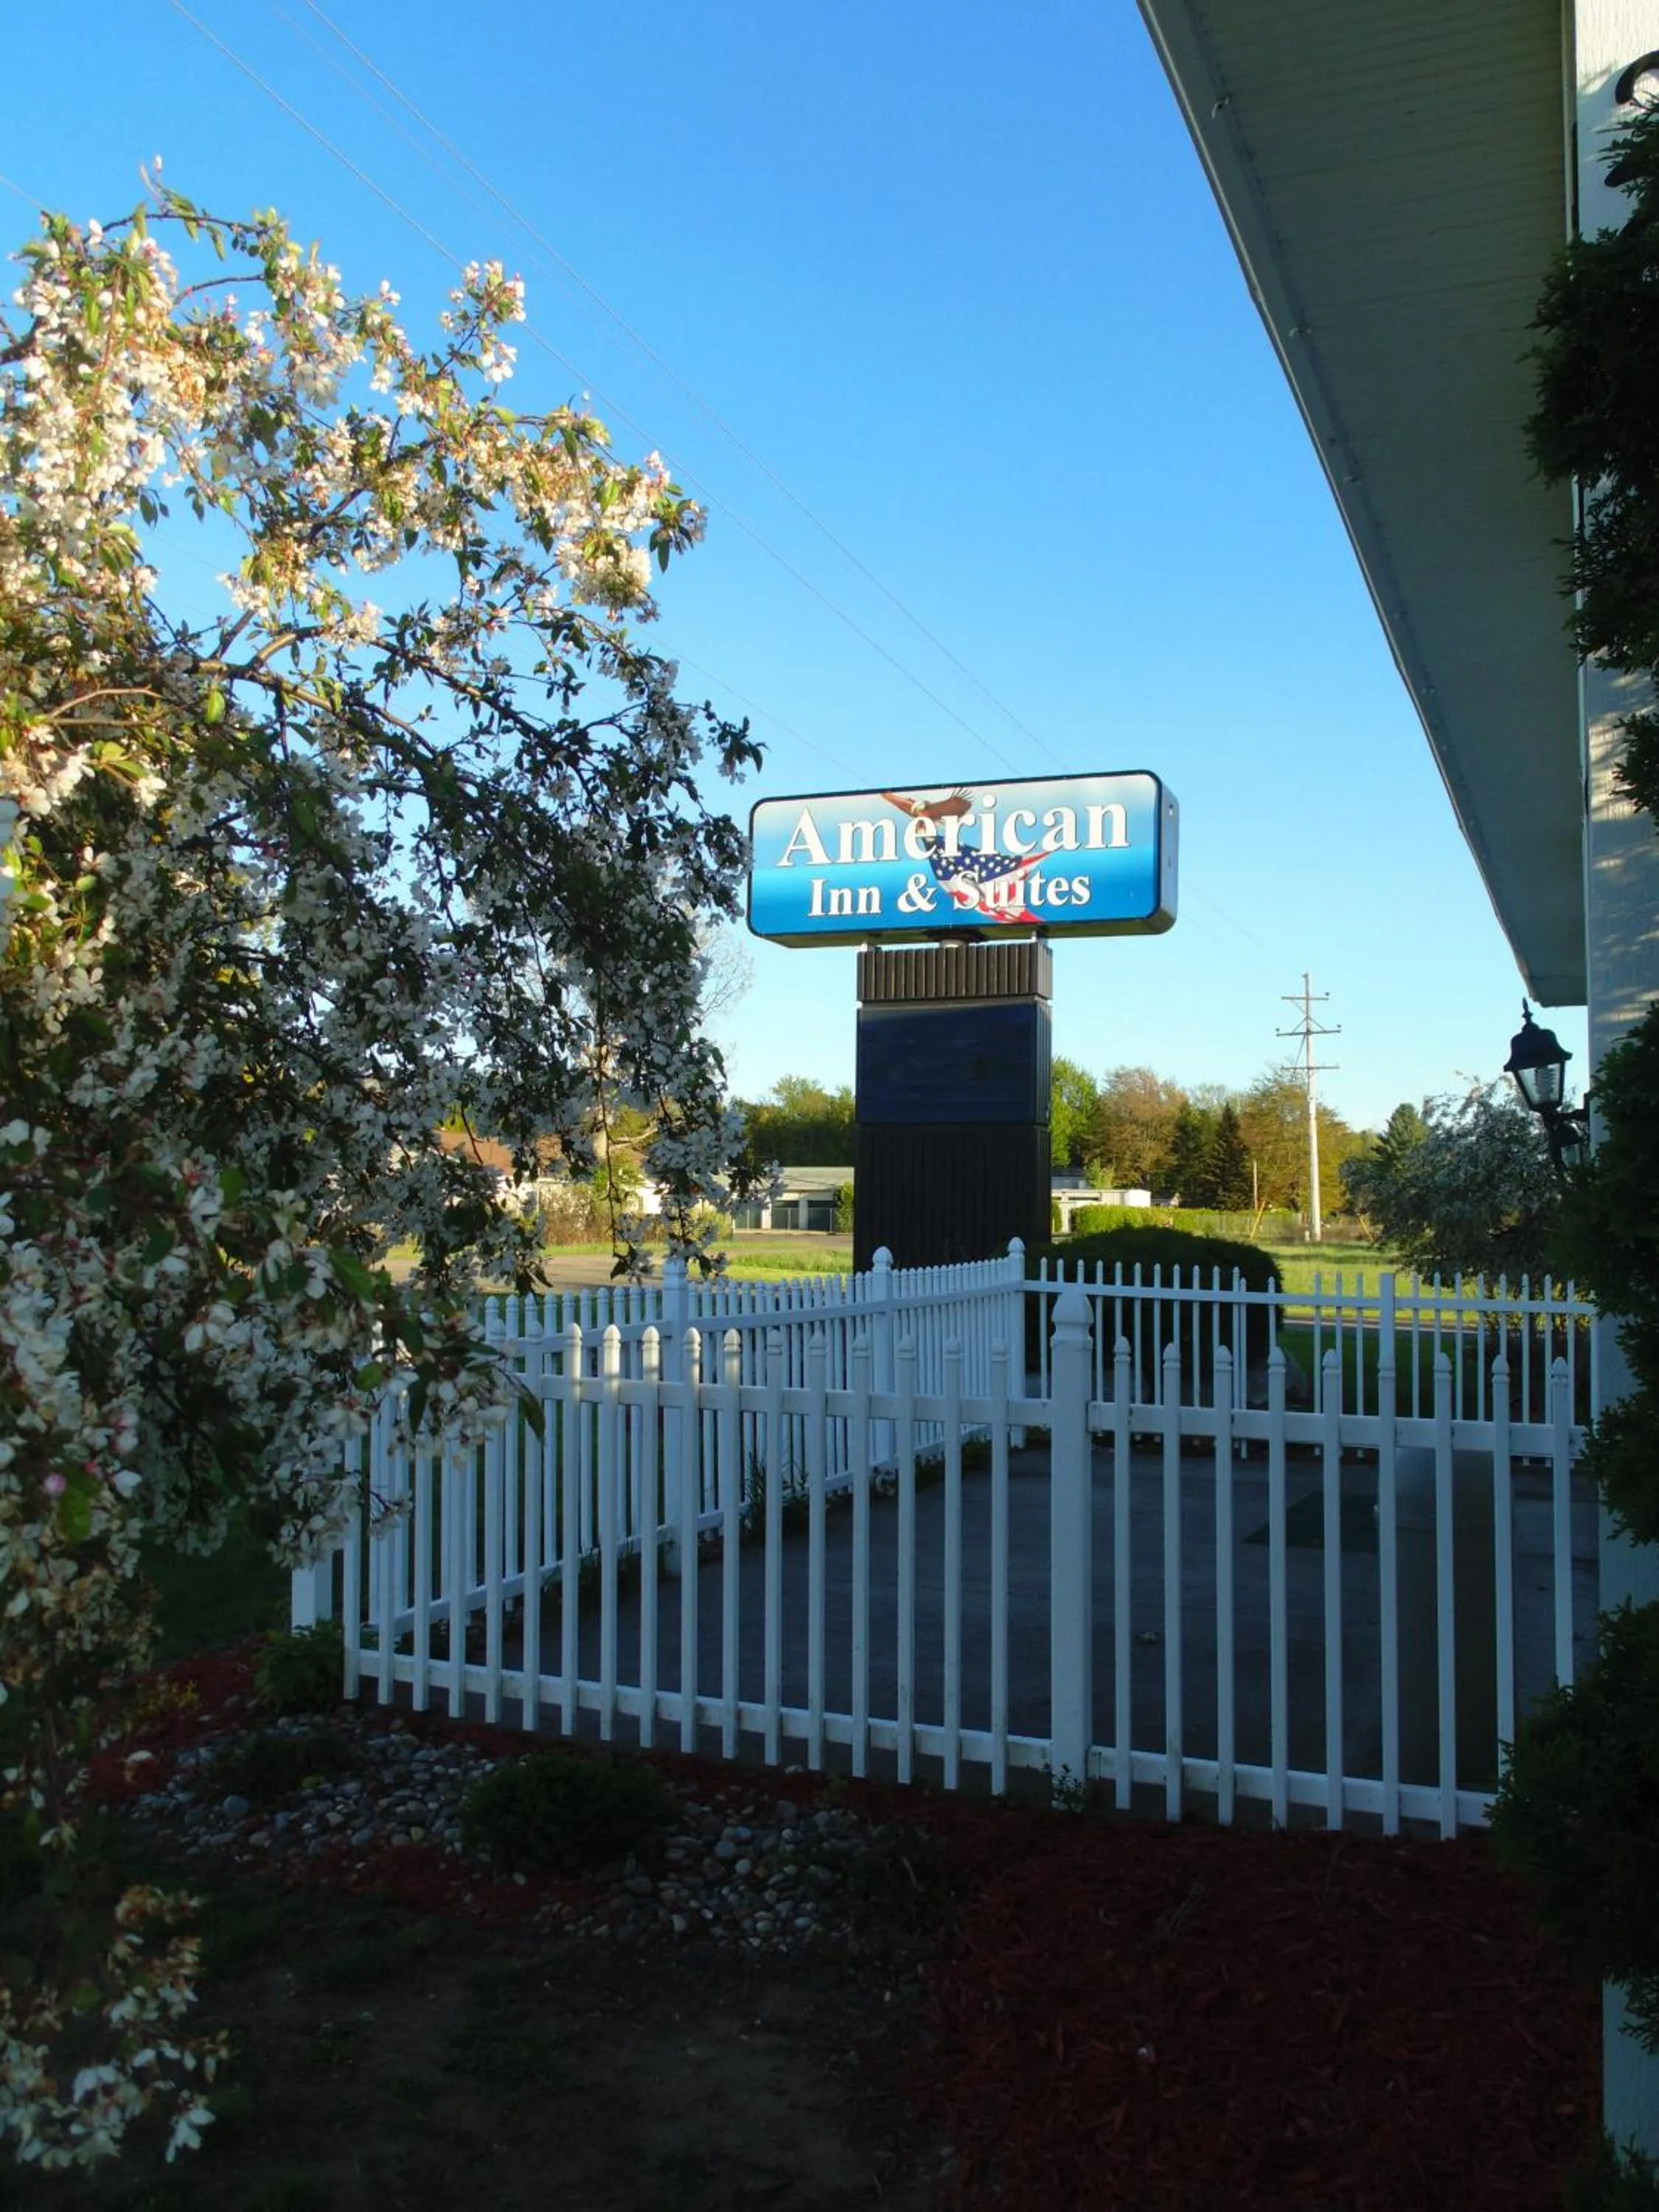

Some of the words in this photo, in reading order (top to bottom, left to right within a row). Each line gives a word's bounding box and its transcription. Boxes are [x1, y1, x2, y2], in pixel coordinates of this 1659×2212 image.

[776, 794, 1130, 866] American
[808, 879, 882, 917] Inn
[897, 873, 937, 913] &
[953, 871, 1091, 910] Suites
